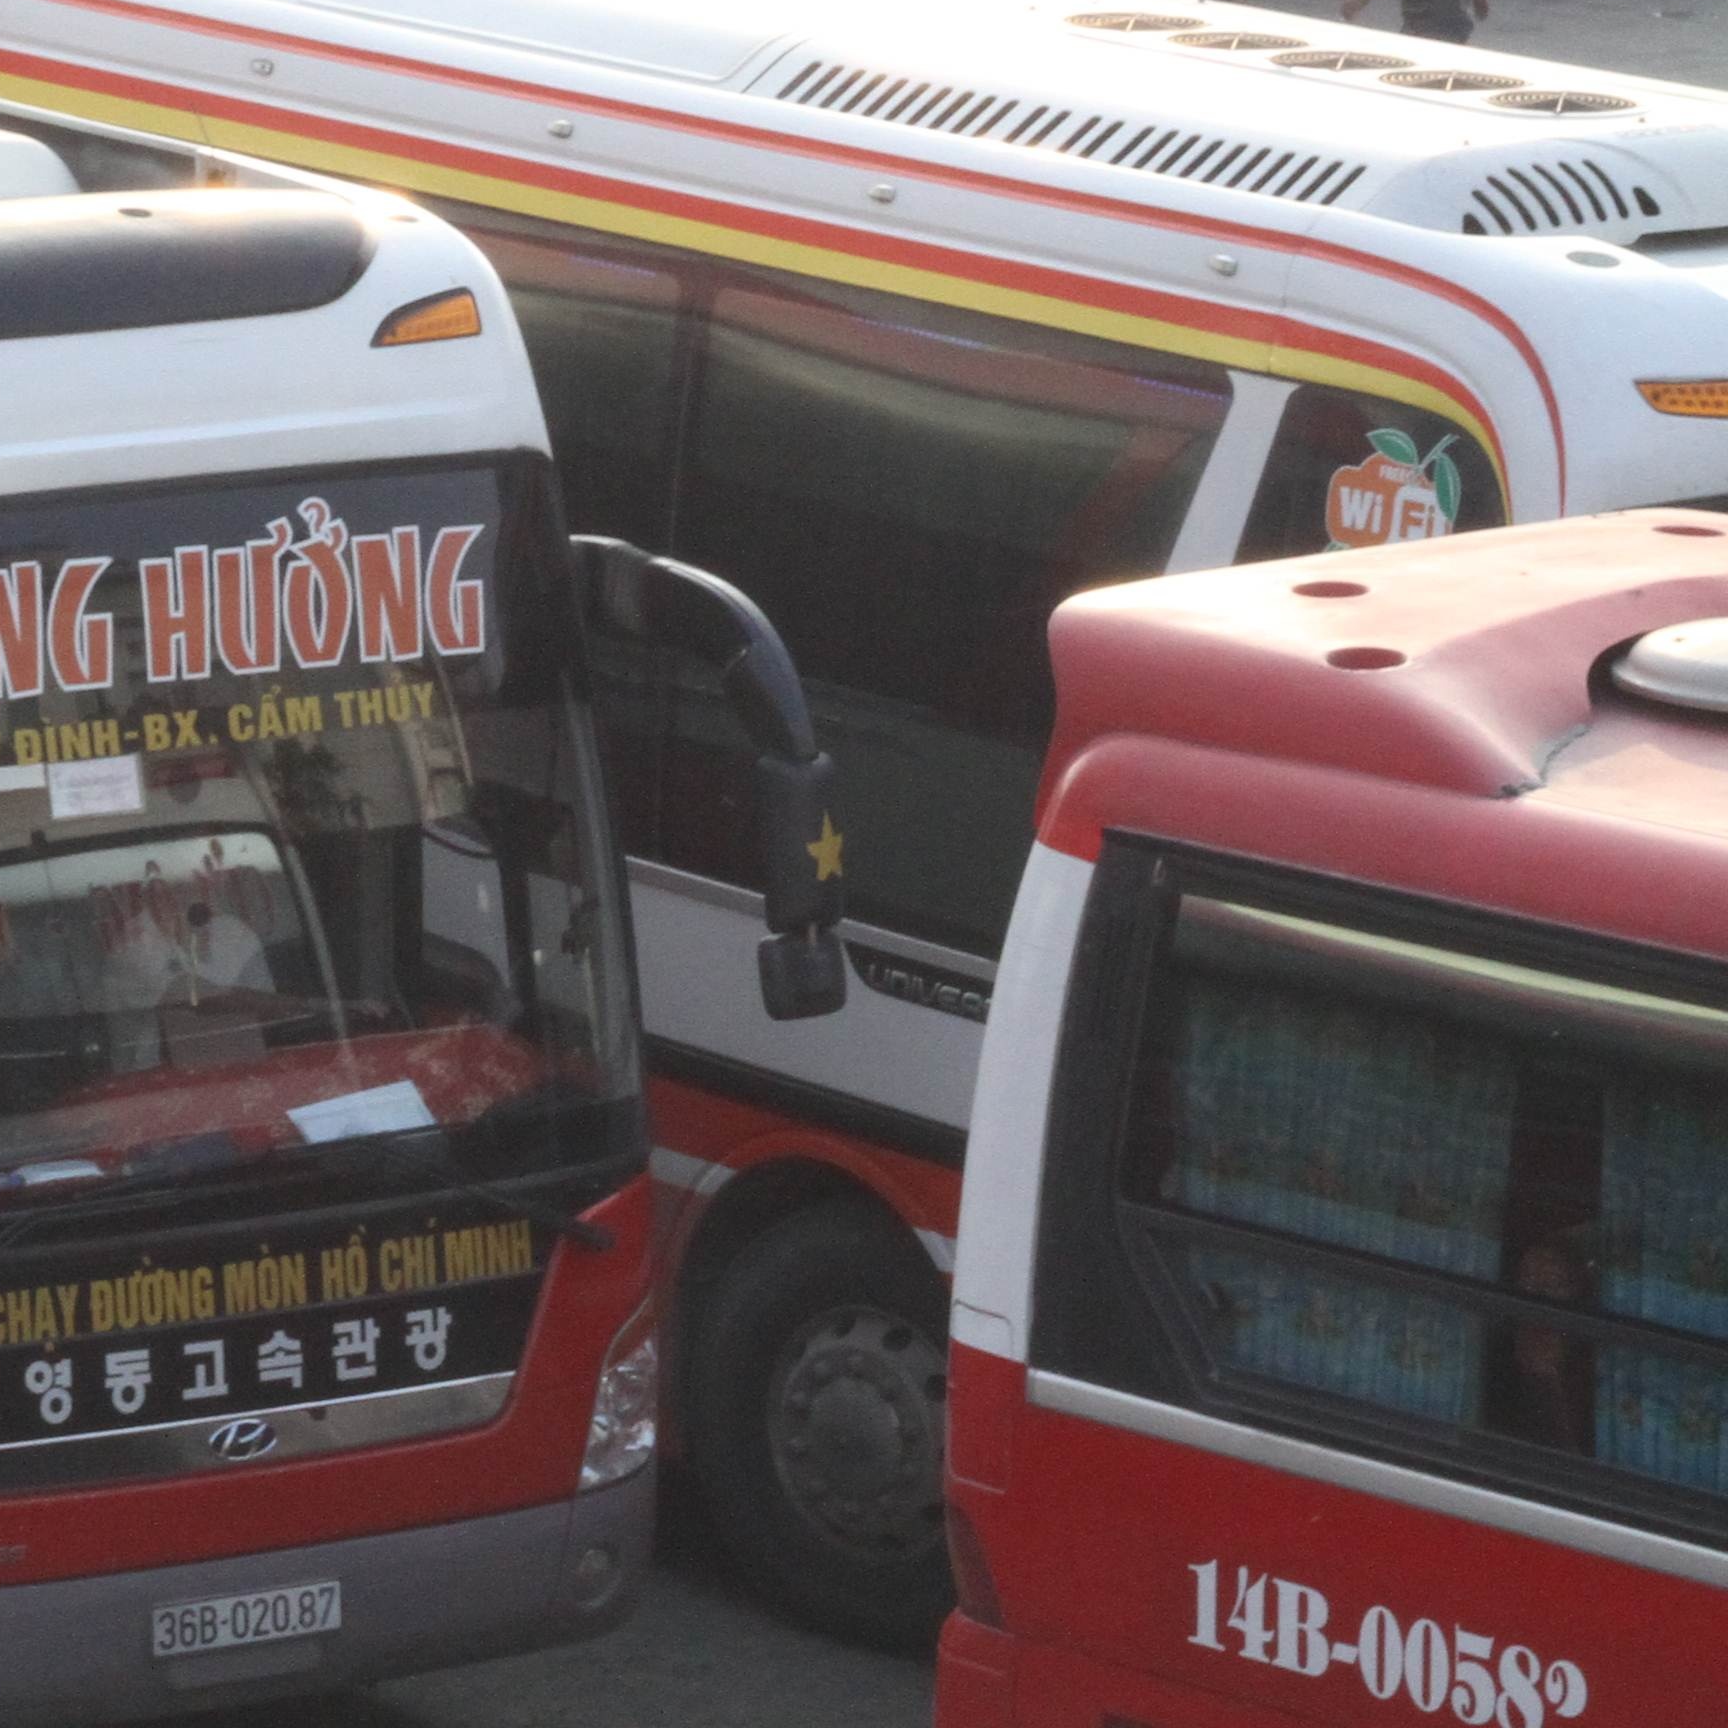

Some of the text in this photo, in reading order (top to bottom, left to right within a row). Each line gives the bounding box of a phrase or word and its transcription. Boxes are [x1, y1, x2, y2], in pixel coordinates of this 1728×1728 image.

[139, 495, 487, 684] HƯỞNG
[227, 684, 324, 745] CẨM
[89, 1256, 217, 1335] ĐƯỜNG
[222, 1242, 311, 1317] MÒN
[320, 1223, 372, 1301] HỒ
[377, 1216, 440, 1291] CHÍ
[441, 1219, 535, 1283] MINH
[158, 1583, 338, 1653] 36B-020.87
